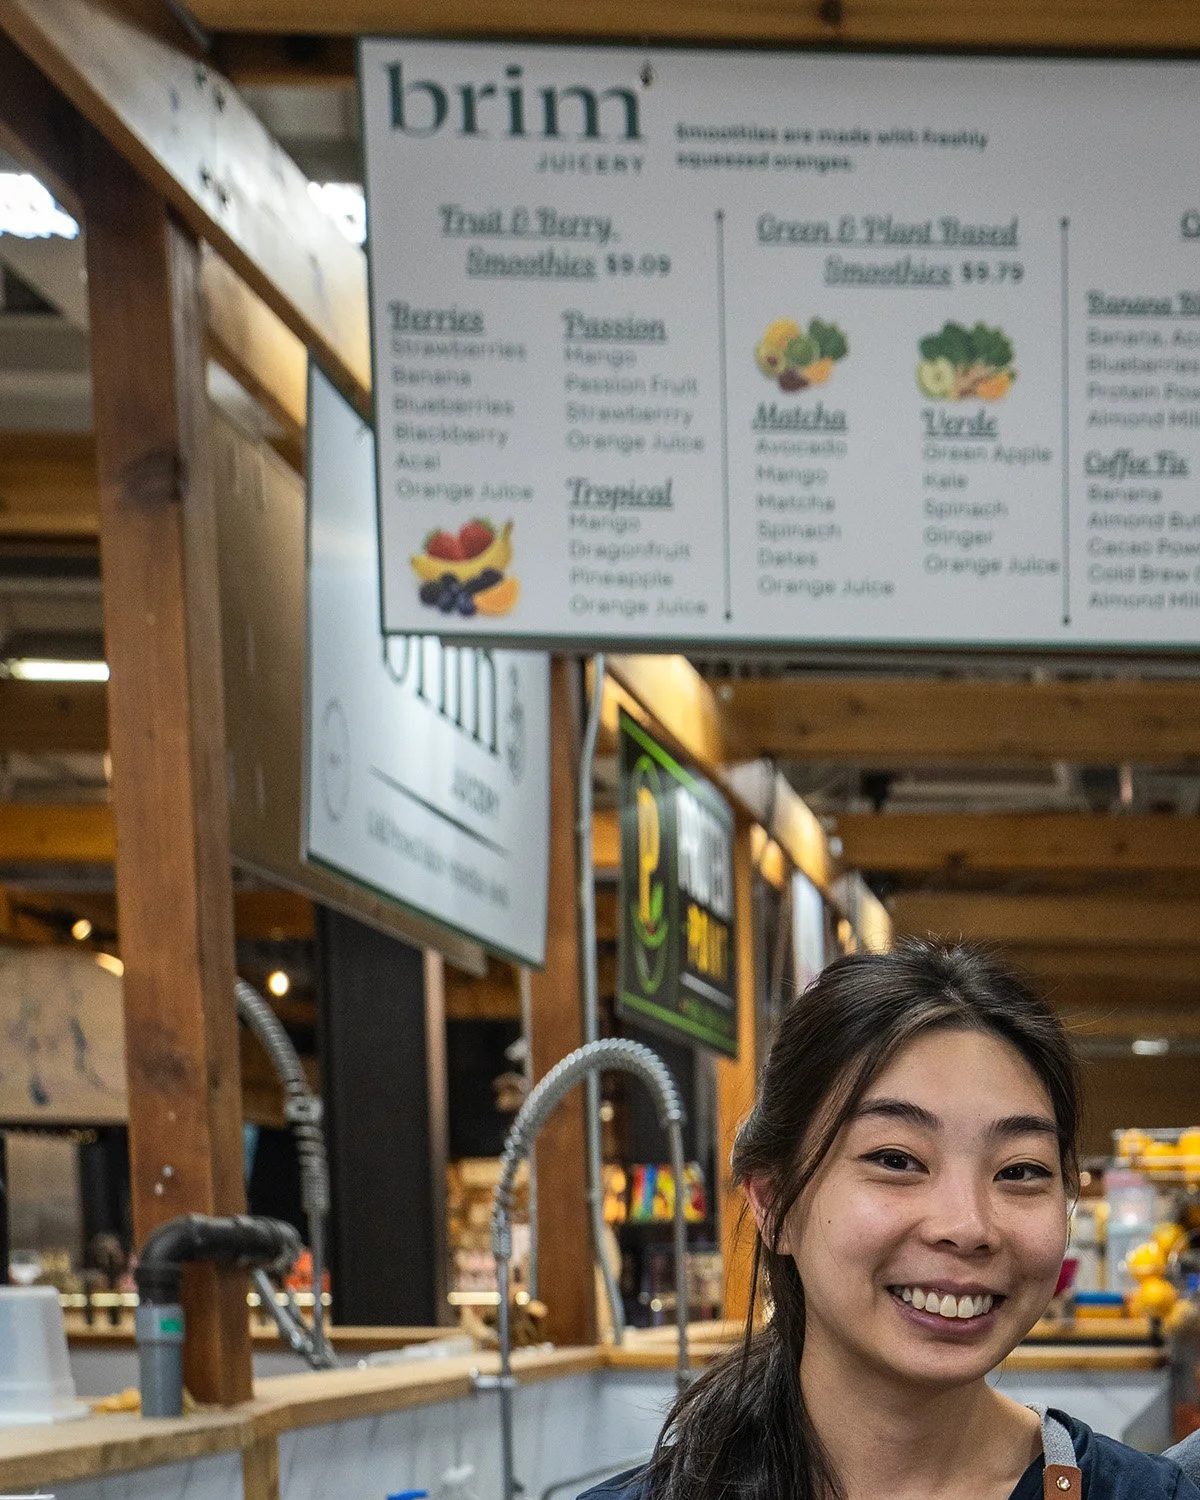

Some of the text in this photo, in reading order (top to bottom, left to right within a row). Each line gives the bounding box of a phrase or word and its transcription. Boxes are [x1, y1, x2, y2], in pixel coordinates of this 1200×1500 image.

[383, 60, 648, 141] brim
[675, 122, 988, 151] Smoothies are made with freshly
[536, 153, 644, 175] JUICERY
[675, 150, 769, 173] squeezed
[438, 203, 504, 238] Fruit
[511, 204, 530, 239] &
[756, 213, 1020, 251] Green & Plant Based
[465, 246, 598, 282] Smoothies
[823, 255, 953, 288] Smoothies
[387, 300, 486, 334] Berries
[1085, 289, 1174, 321] Banana
[560, 308, 668, 343] Passion
[1086, 354, 1200, 376] Blueberries
[1086, 382, 1161, 402] Protein
[751, 401, 849, 436] Matcha
[920, 408, 1000, 440] Verde
[1086, 410, 1164, 429] Almond
[1083, 448, 1151, 483] Coffee
[565, 476, 676, 513] Tropical
[1087, 484, 1162, 504] Banana
[1087, 511, 1165, 531] Almond
[1088, 564, 1136, 584] Cold
[1139, 564, 1190, 584] Brew
